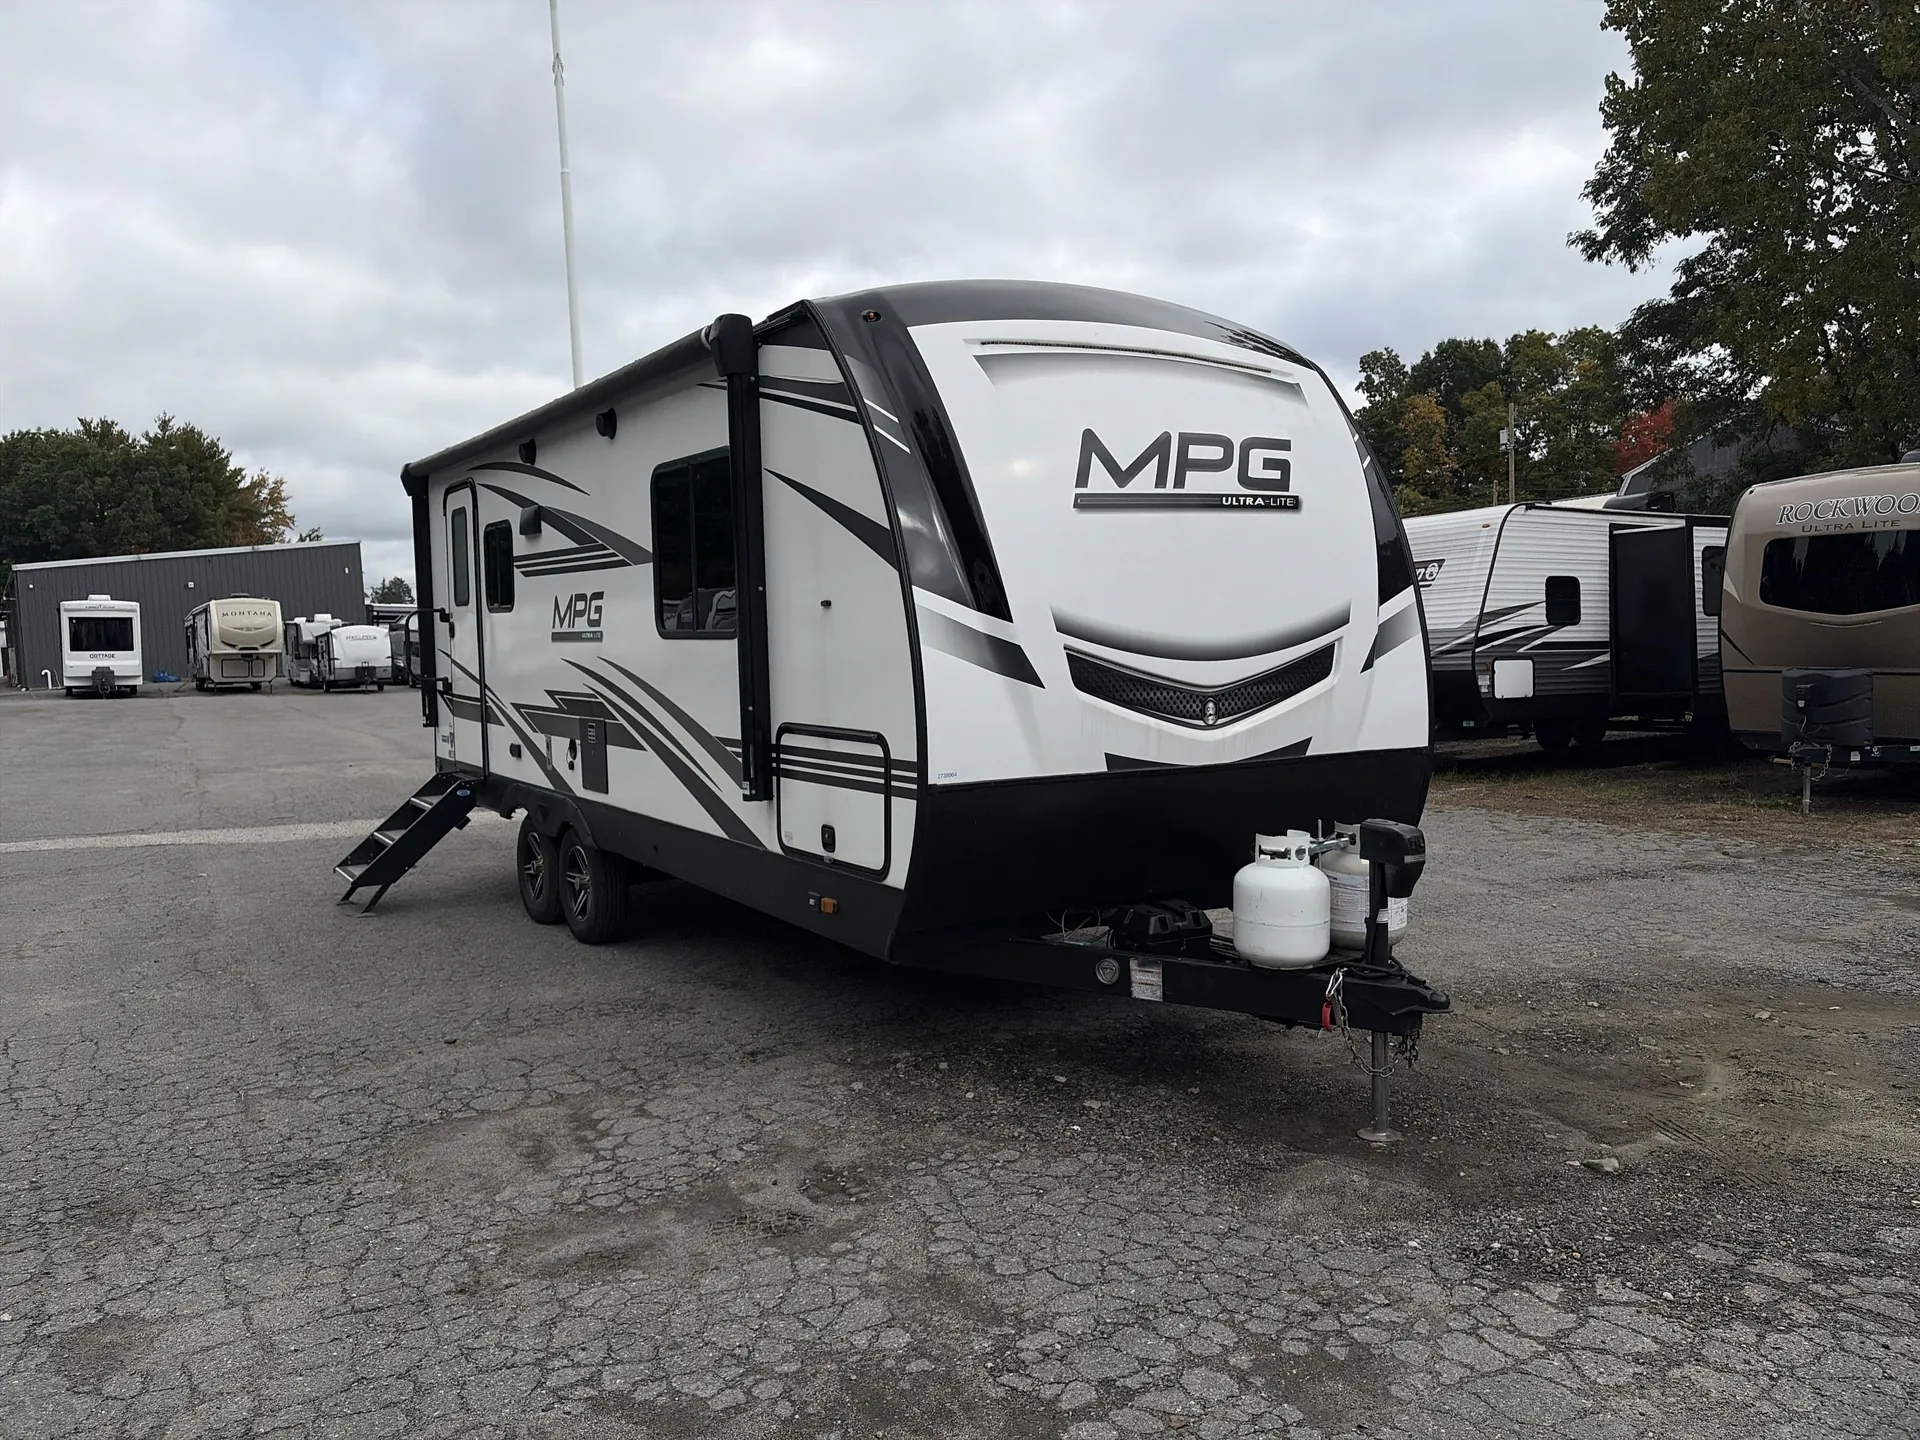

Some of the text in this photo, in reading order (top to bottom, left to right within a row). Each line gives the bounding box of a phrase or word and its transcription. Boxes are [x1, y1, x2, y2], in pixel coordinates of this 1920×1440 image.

[1075, 428, 1292, 492] MPG
[1222, 496, 1296, 507] ULTRA-LITE
[1776, 493, 1920, 525] ROCKWOO
[1801, 519, 1900, 533] ULTRA LITE
[552, 591, 604, 629] MPG
